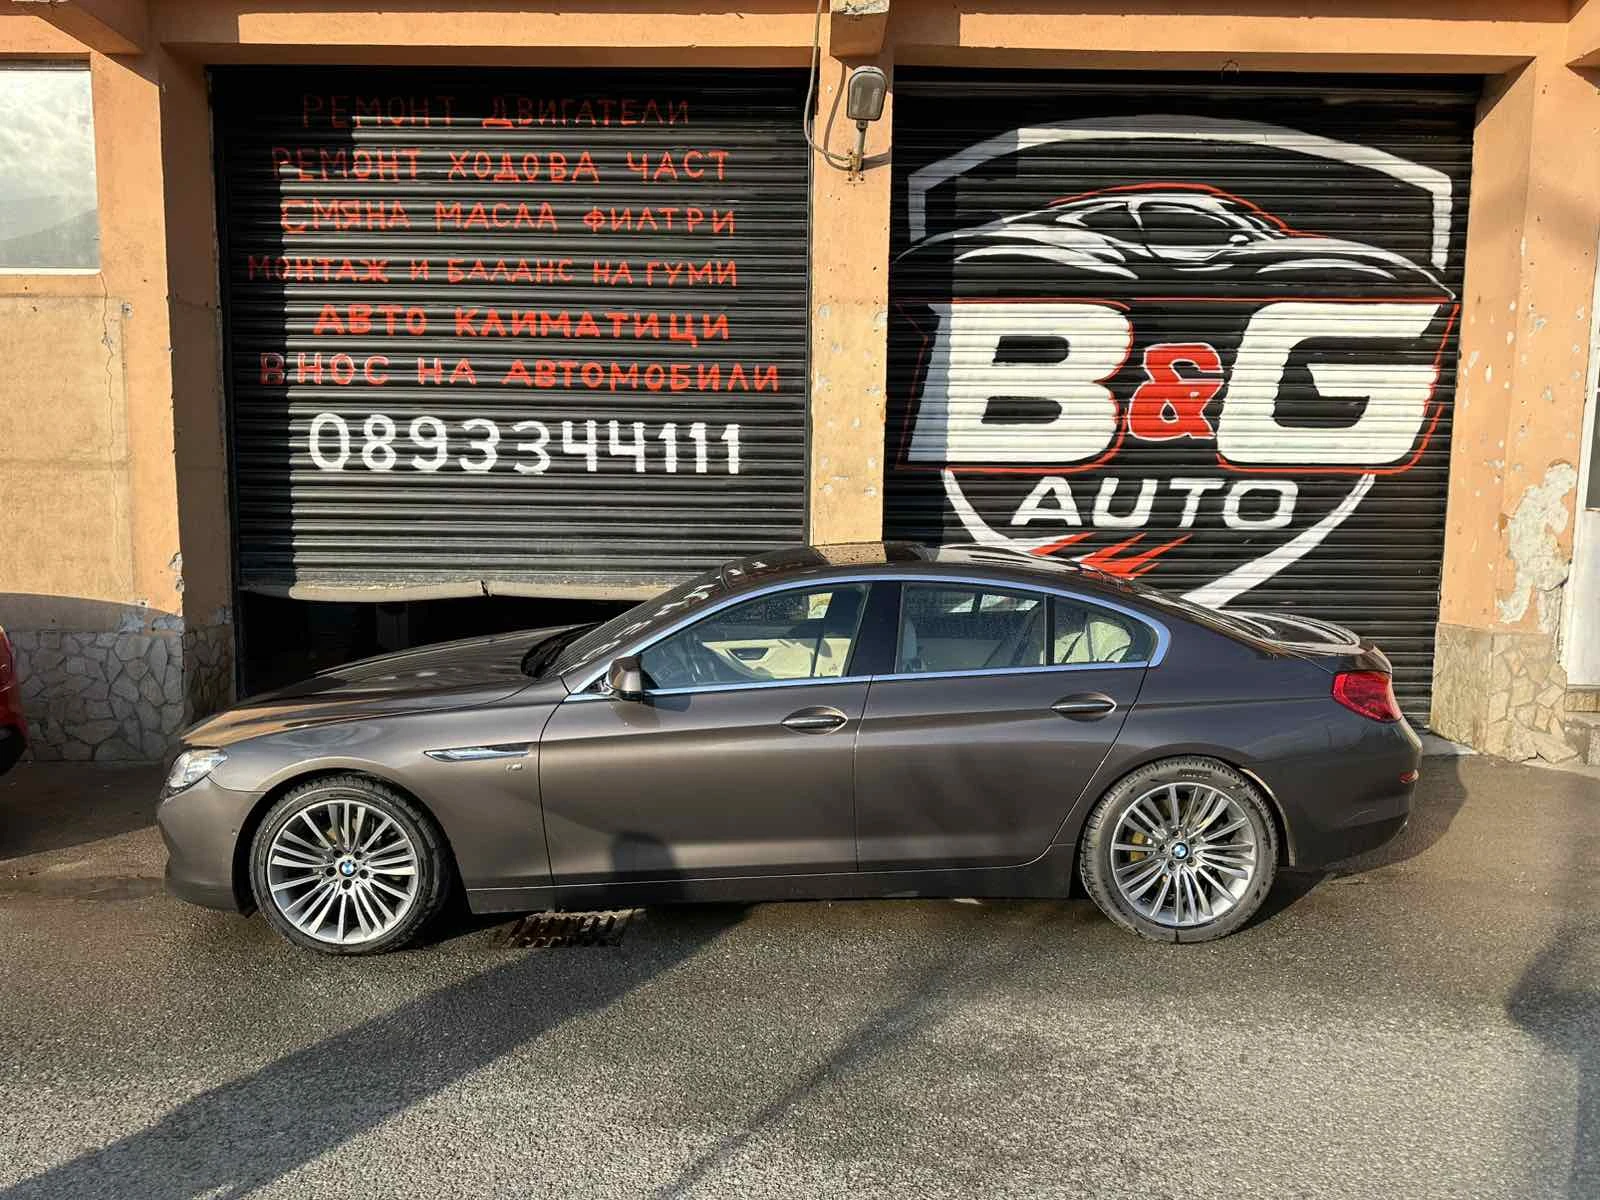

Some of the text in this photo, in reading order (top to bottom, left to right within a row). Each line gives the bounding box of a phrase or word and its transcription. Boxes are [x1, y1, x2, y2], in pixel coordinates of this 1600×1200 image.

[302, 93, 690, 129] РЕМОНТ ДВИГАТЕЛИ
[271, 146, 731, 183] РЕМОНТ ХОДОВА ЧАСТ
[279, 199, 736, 236] СМЯНА МАСЛА ФИЛТРИ
[246, 255, 738, 287] МОНТАЖ И БАЛАНС НА ГУМИ
[312, 303, 730, 347] АВТО КЛИМАТИЦИ
[260, 352, 781, 392] ВНОС НА АВТОМОБИЛИ
[907, 301, 1442, 466] B&G
[307, 411, 741, 475] 0893344111
[1010, 475, 1299, 530] AUTO
